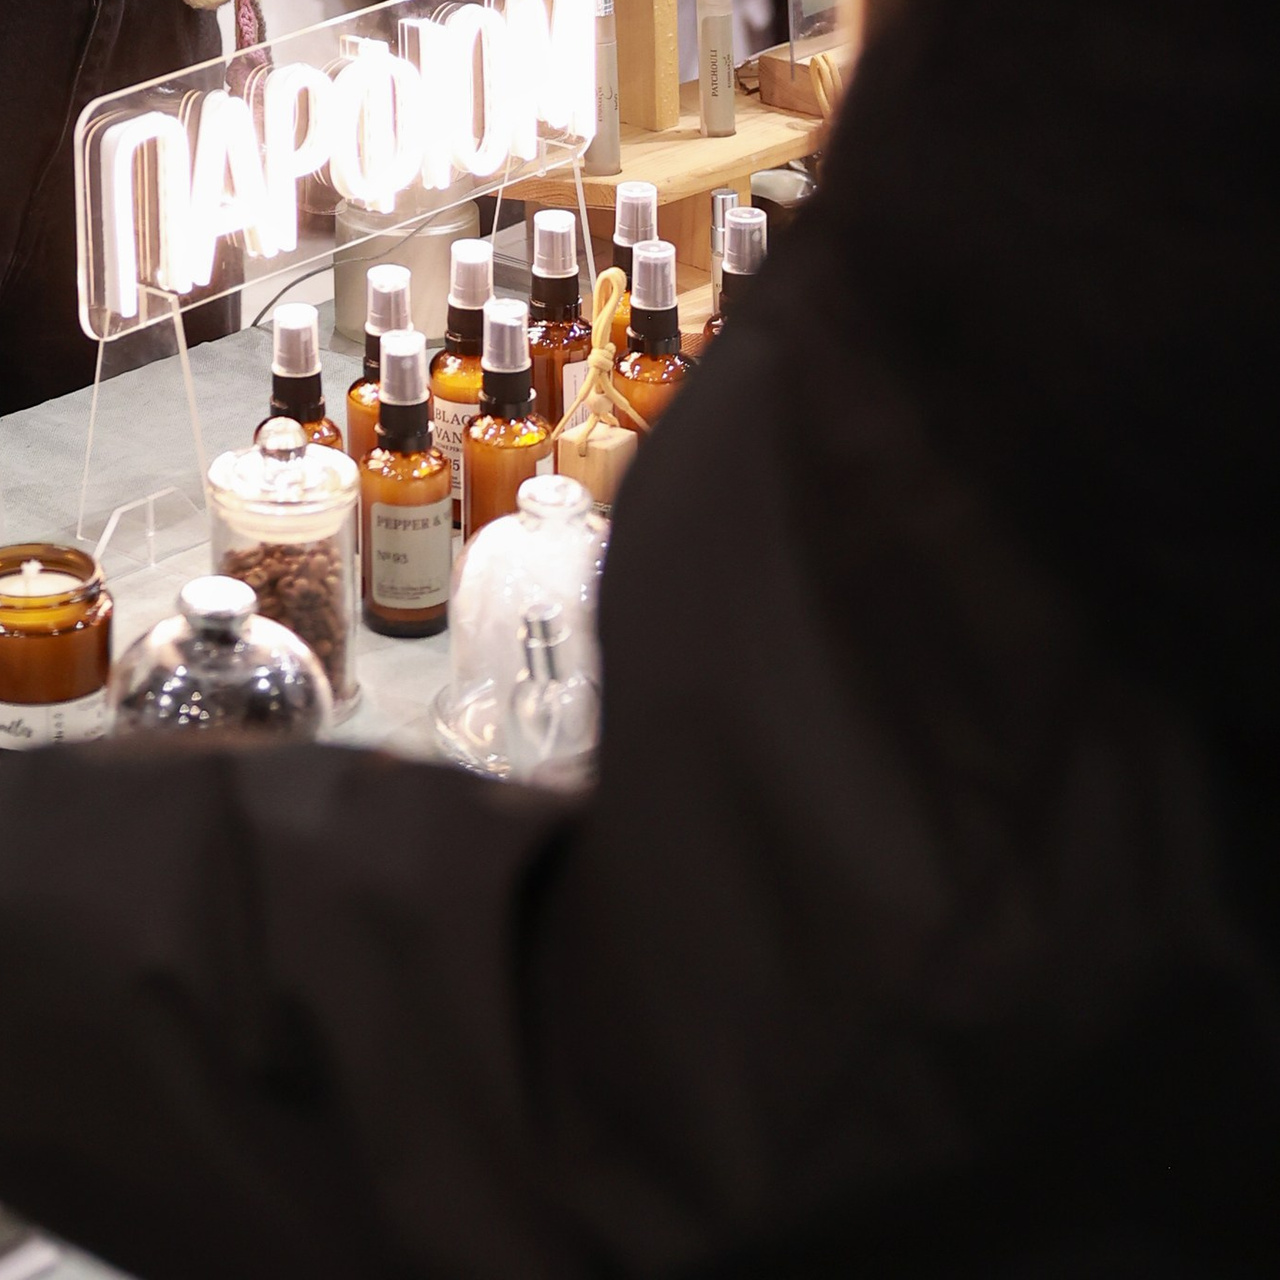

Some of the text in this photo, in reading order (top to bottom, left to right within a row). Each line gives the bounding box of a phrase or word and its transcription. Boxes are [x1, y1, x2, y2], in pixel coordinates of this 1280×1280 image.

[710, 49, 718, 97] PATCHOULI
[435, 408, 471, 426] BLAC
[435, 426, 463, 444] VAN
[376, 515, 429, 531] PEPPER
[432, 514, 441, 526] &
